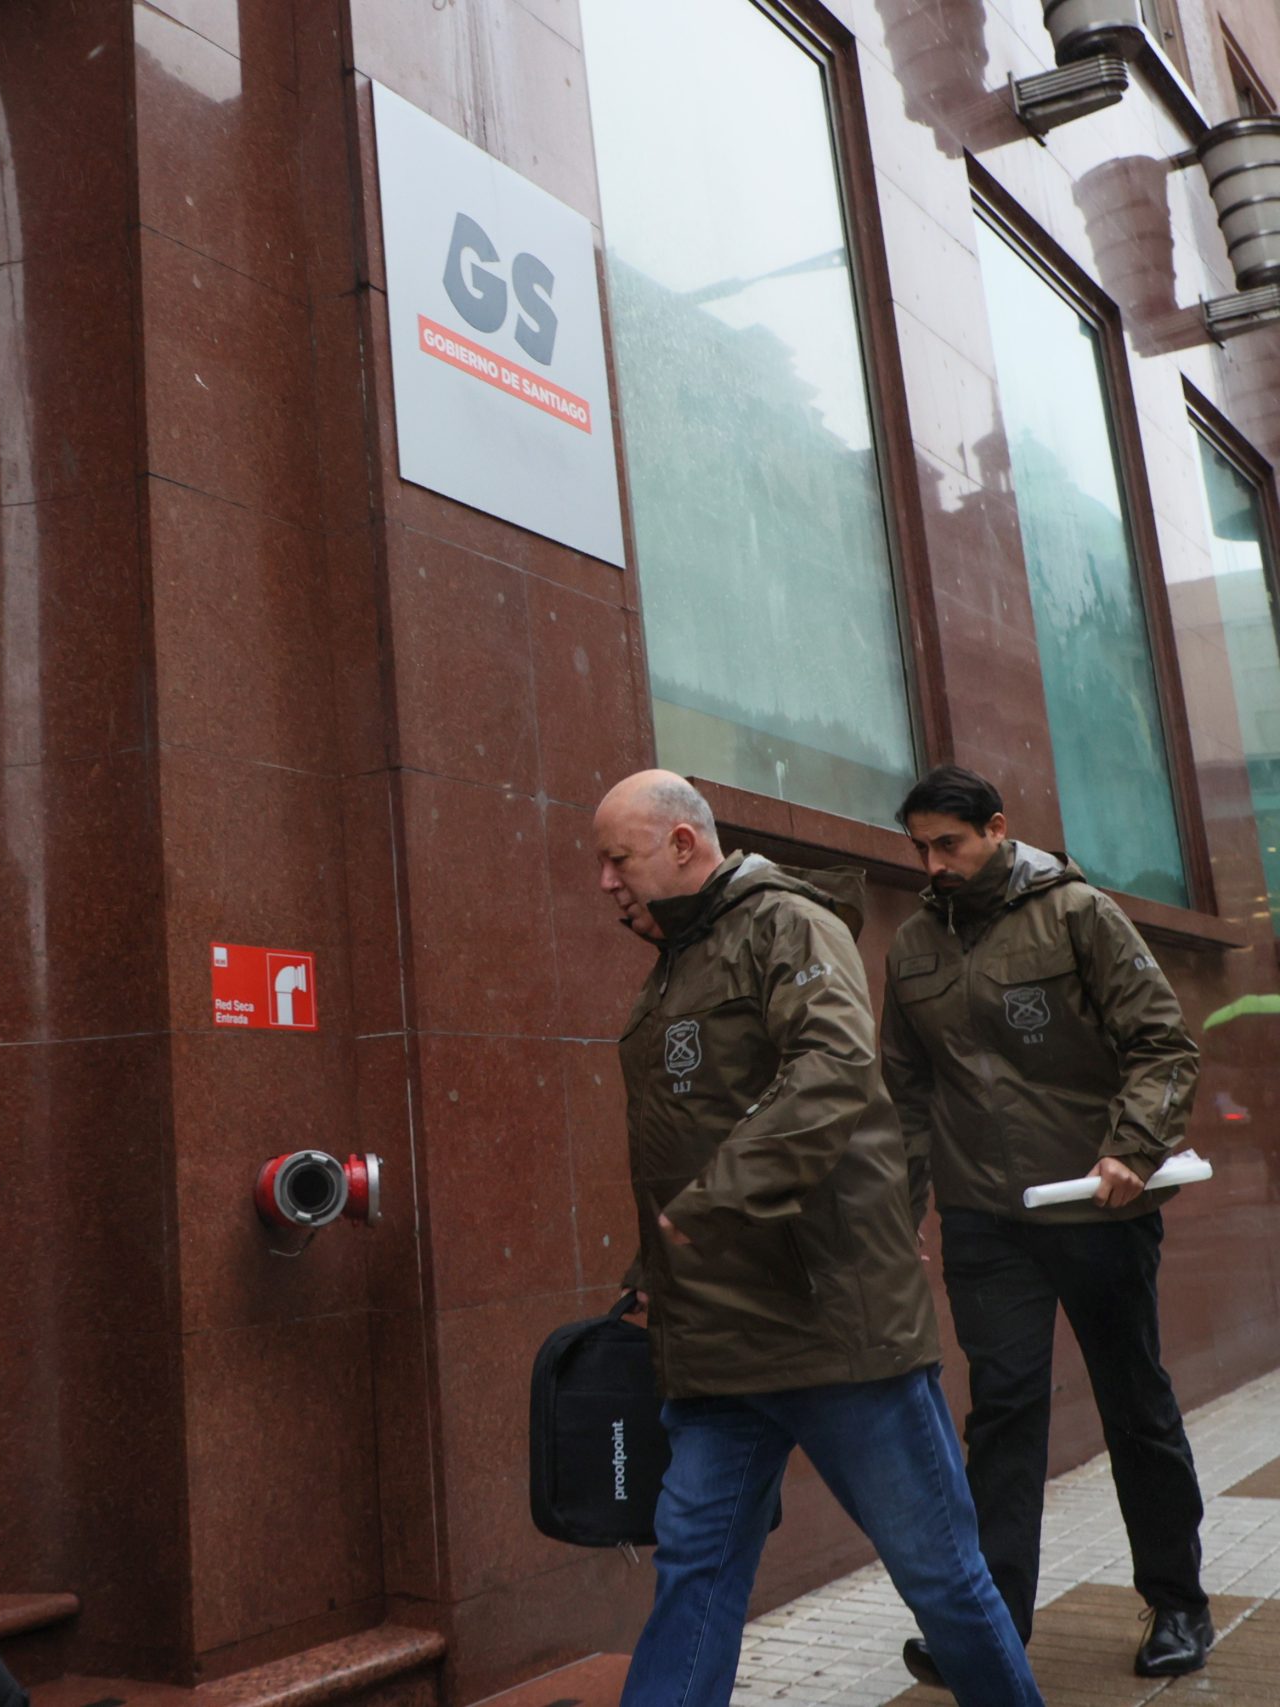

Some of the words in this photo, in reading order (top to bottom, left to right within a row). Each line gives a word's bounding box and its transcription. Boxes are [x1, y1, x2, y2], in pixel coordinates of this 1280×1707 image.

[443, 212, 558, 366] GS
[423, 328, 499, 378] GOBIERNO
[502, 367, 520, 390] DE
[521, 379, 587, 424] SANTIAGO
[215, 999, 232, 1010] Red
[234, 1000, 254, 1012] Seca
[216, 1012, 248, 1024] Entrada
